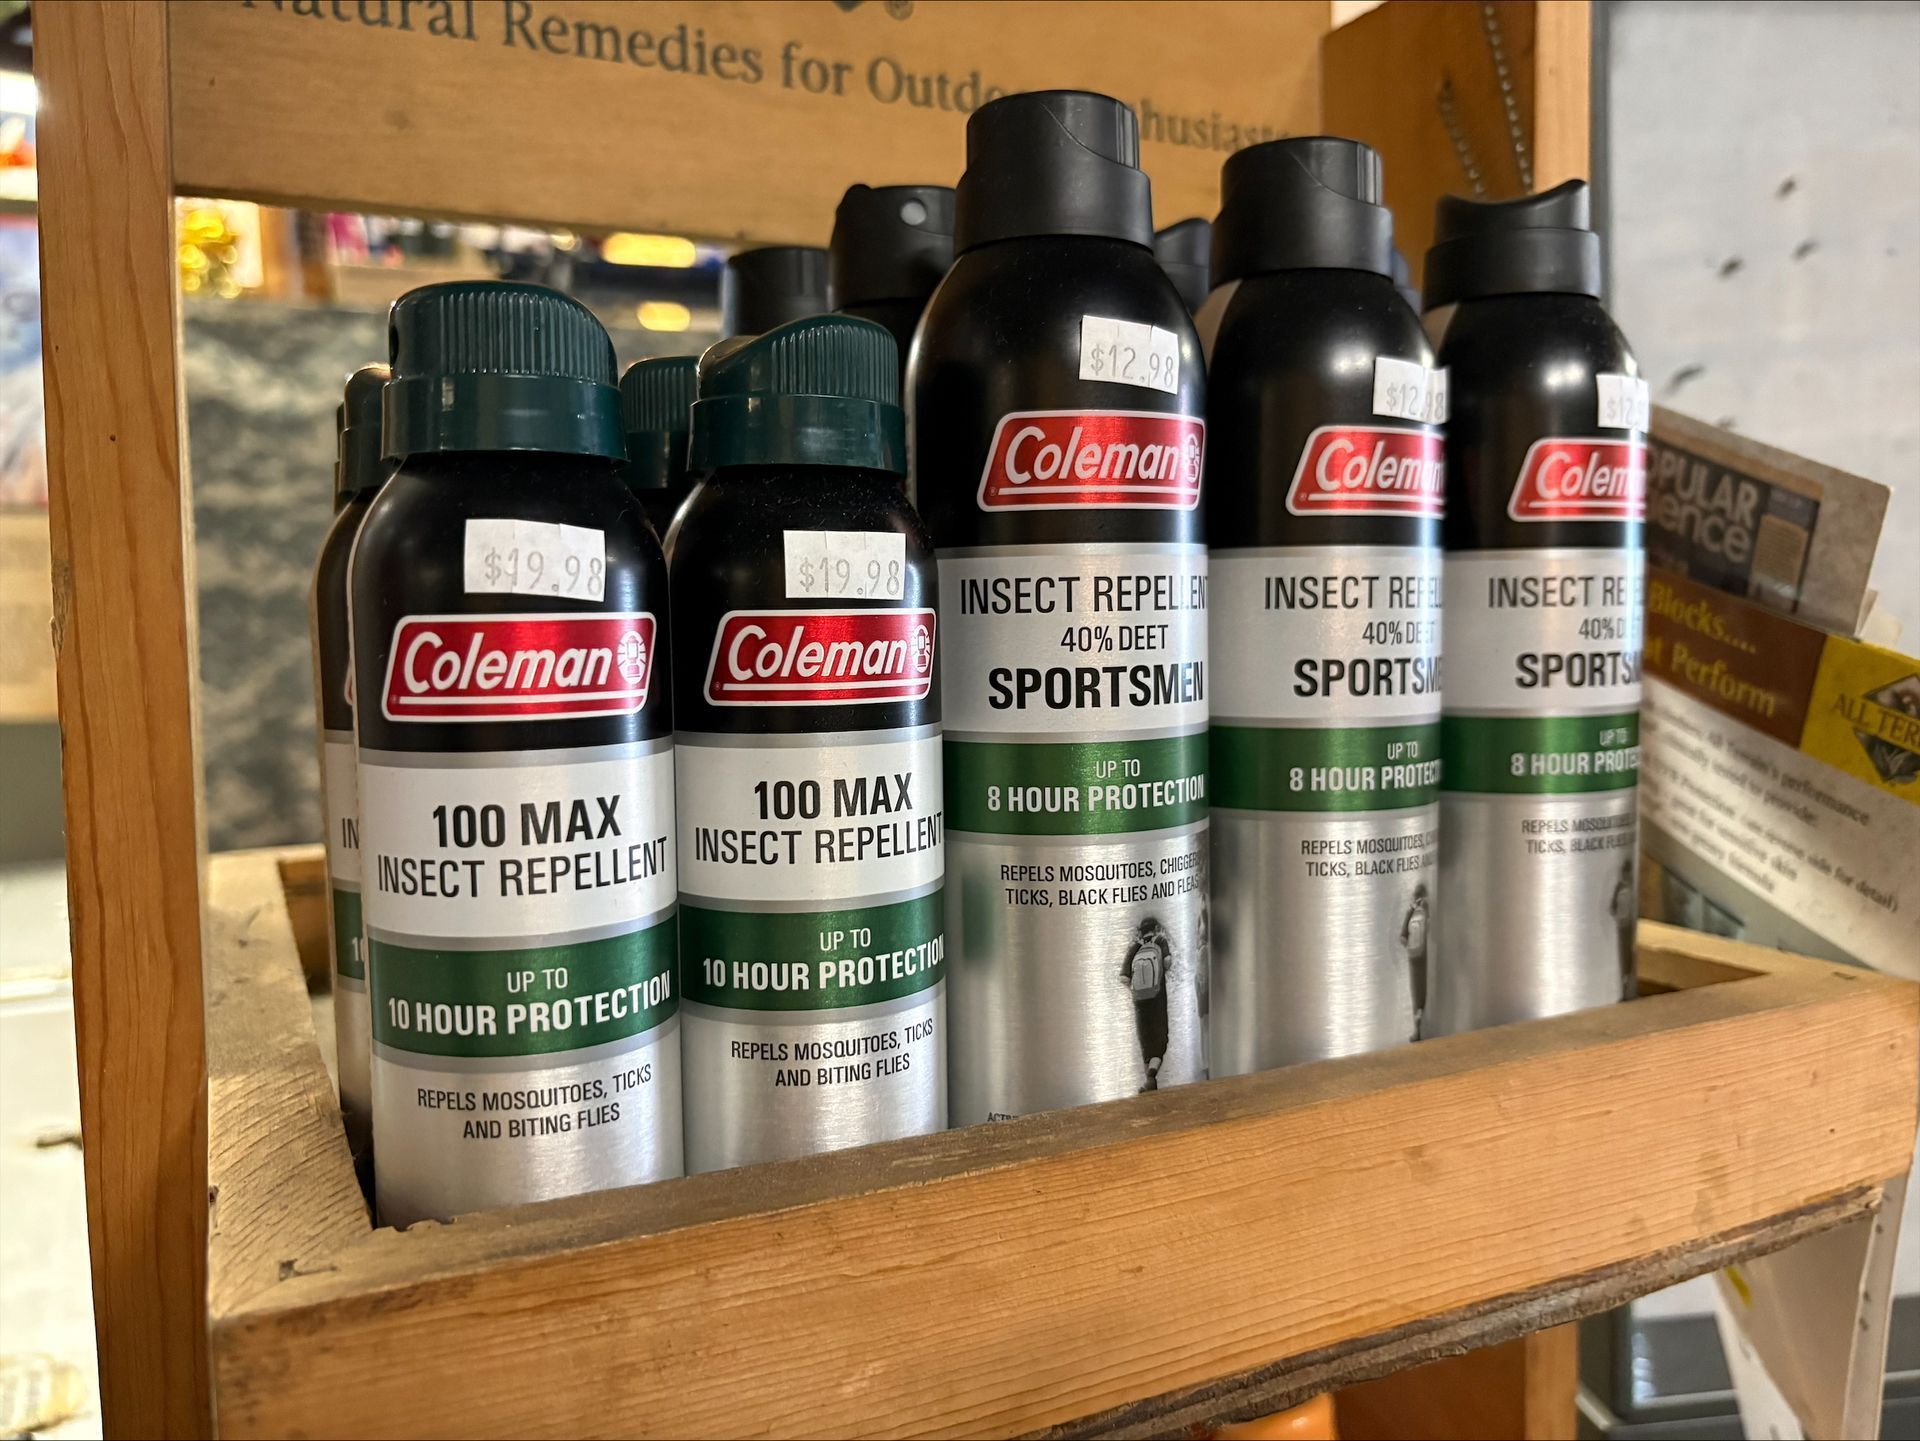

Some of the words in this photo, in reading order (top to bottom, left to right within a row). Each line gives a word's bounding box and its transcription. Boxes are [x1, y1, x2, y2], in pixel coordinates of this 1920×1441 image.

[241, 0, 478, 41] atural
[502, 1, 764, 84] Remedies
[781, 41, 853, 97] for
[1090, 343, 1174, 389] $12.98
[1005, 426, 1181, 485] Coleman
[484, 547, 602, 597] $19.98
[800, 557, 900, 595] $19.98
[961, 576, 1080, 615] INSECT
[1264, 576, 1379, 610] INSECT
[1488, 576, 1594, 608] INSECT
[1060, 625, 1113, 653] 40%
[1119, 624, 1169, 651] DEET
[1362, 621, 1402, 645] 40%
[1579, 617, 1613, 640] 40%
[404, 631, 613, 694] Coleman
[728, 625, 908, 681] Coleman
[1515, 652, 1640, 688] SPORTS
[988, 661, 1203, 710] SPORTSMEN
[1672, 641, 1776, 718] Perform
[1829, 693, 1869, 727] ALL
[1095, 760, 1117, 779] UP
[1121, 758, 1140, 778] TO
[1387, 743, 1403, 760] UP
[1406, 741, 1419, 758] TO
[1510, 752, 1525, 776] 8
[1531, 751, 1589, 776] HOUR
[754, 780, 821, 820] 100
[834, 772, 913, 818] MAX
[987, 786, 1001, 812] 8
[1008, 786, 1080, 813] HOUR
[1088, 773, 1205, 812] PROTECTION
[1289, 767, 1303, 791] 8
[1311, 767, 1375, 791] HOUR
[433, 805, 506, 848] 100
[521, 795, 622, 846] MAX
[695, 827, 802, 865] INSECT
[815, 811, 943, 864] REPELLENT
[1522, 819, 1568, 834] REPELS
[1301, 840, 1352, 856] REPELS
[1305, 861, 1351, 878] TICKS,
[1355, 859, 1395, 876] BLACK
[1397, 855, 1419, 872] FLIES
[377, 854, 485, 898] INSECT
[500, 836, 667, 897] REPELLENT
[1001, 864, 1055, 883] REPELS
[1059, 861, 1157, 884] MOSQUITOES,
[1005, 888, 1053, 908] TICKS,
[1058, 888, 1108, 907] BLACK
[1112, 885, 1148, 904] FLIES
[1151, 881, 1175, 900] AND
[820, 931, 844, 952] UP
[850, 928, 871, 948] TO
[703, 958, 726, 986] 10
[733, 961, 810, 991] HOUR
[819, 933, 944, 989] PROTECTION
[507, 970, 535, 995] UP
[542, 968, 568, 989] TO
[388, 997, 410, 1030] 10
[416, 1003, 497, 1036] HOUR
[507, 970, 671, 1034] PROTECTION
[731, 1040, 788, 1061] REPELS
[794, 1032, 901, 1061] MOSQUITOES,
[905, 1018, 933, 1044] TICKS
[417, 1087, 476, 1111] REPELS
[482, 1079, 608, 1111] MOSQUITOES,
[612, 1063, 652, 1094] TICKS
[775, 1069, 810, 1087] AND
[818, 1063, 871, 1086] BITING
[877, 1053, 910, 1078] FLIES
[463, 1120, 501, 1139] AND
[508, 1113, 571, 1138] BITING
[577, 1102, 621, 1130] FLIES
